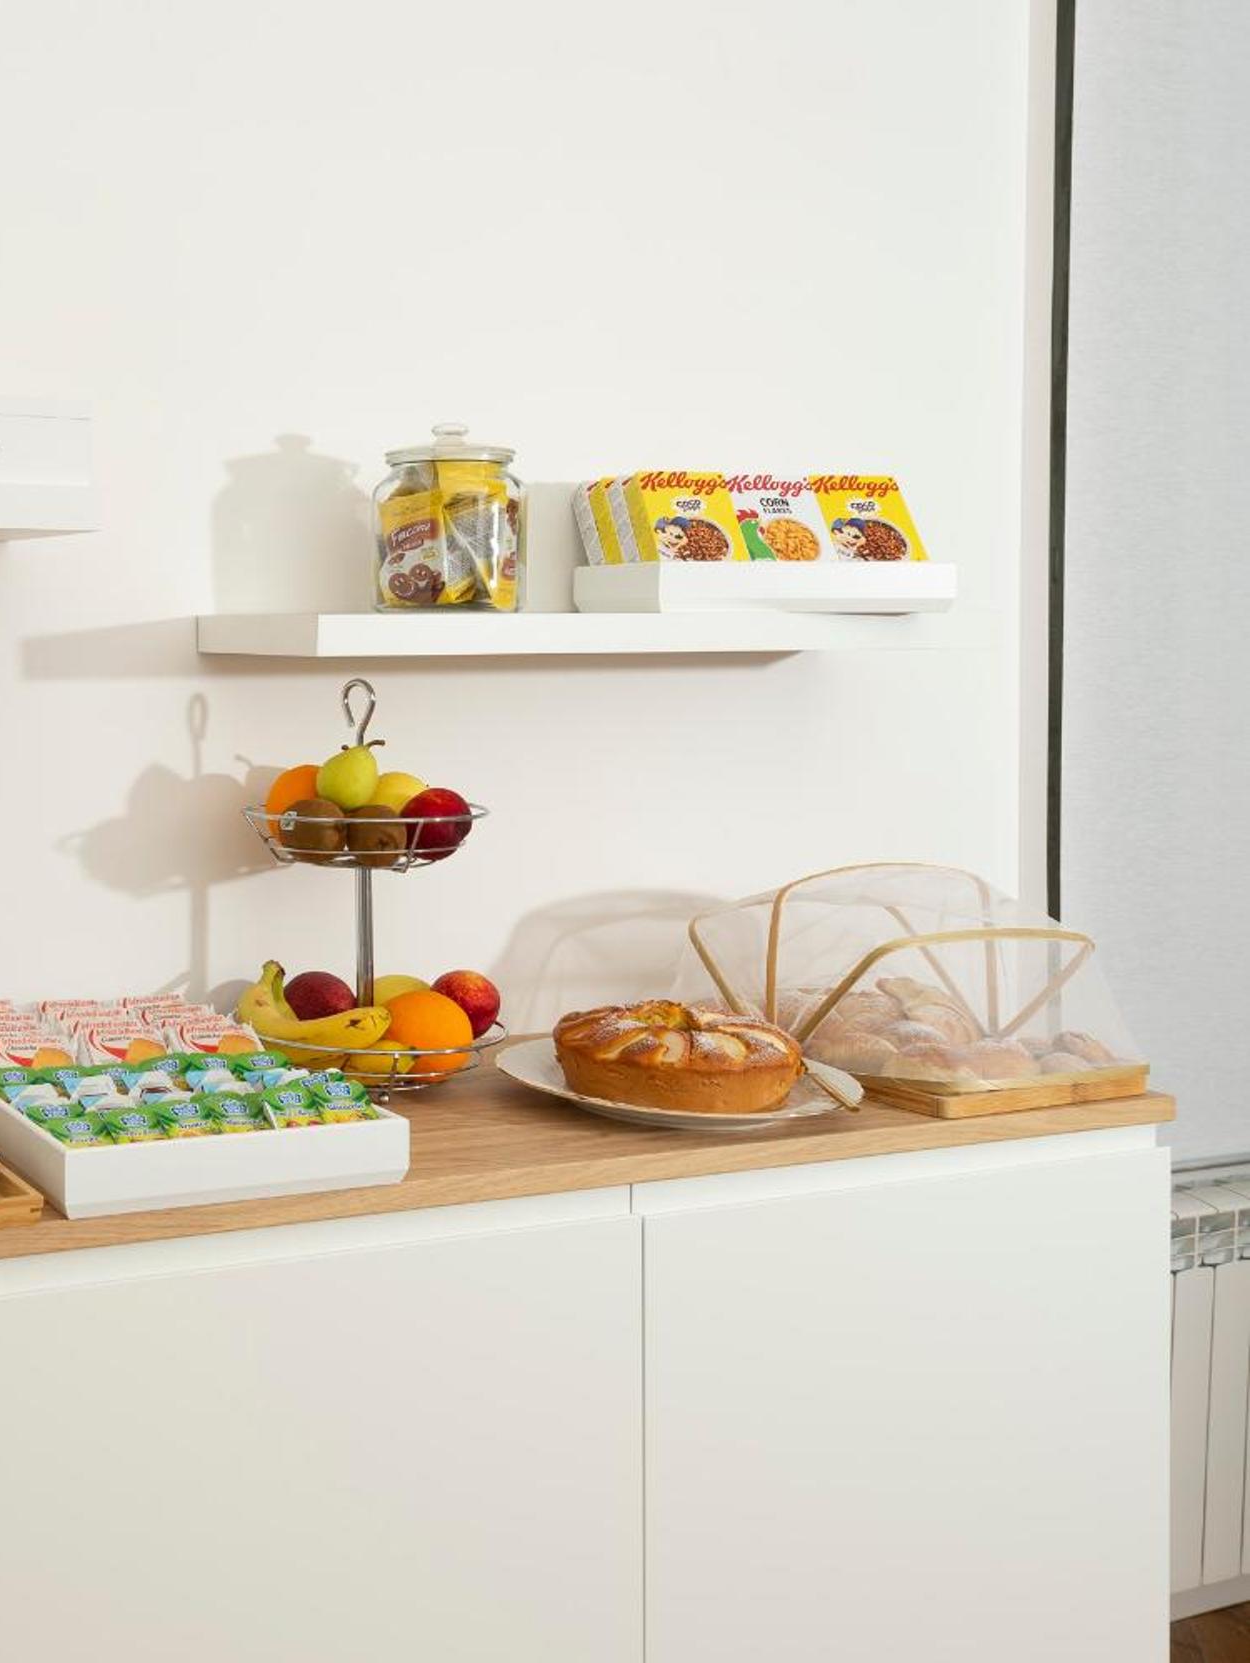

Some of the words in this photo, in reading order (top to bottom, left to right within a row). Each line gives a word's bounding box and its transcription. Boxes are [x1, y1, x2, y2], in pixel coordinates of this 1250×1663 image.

[639, 471, 727, 495] Kellogg's
[726, 474, 813, 497] Kellogg's
[811, 475, 899, 497] Kellogg's
[760, 497, 790, 508] CORN
